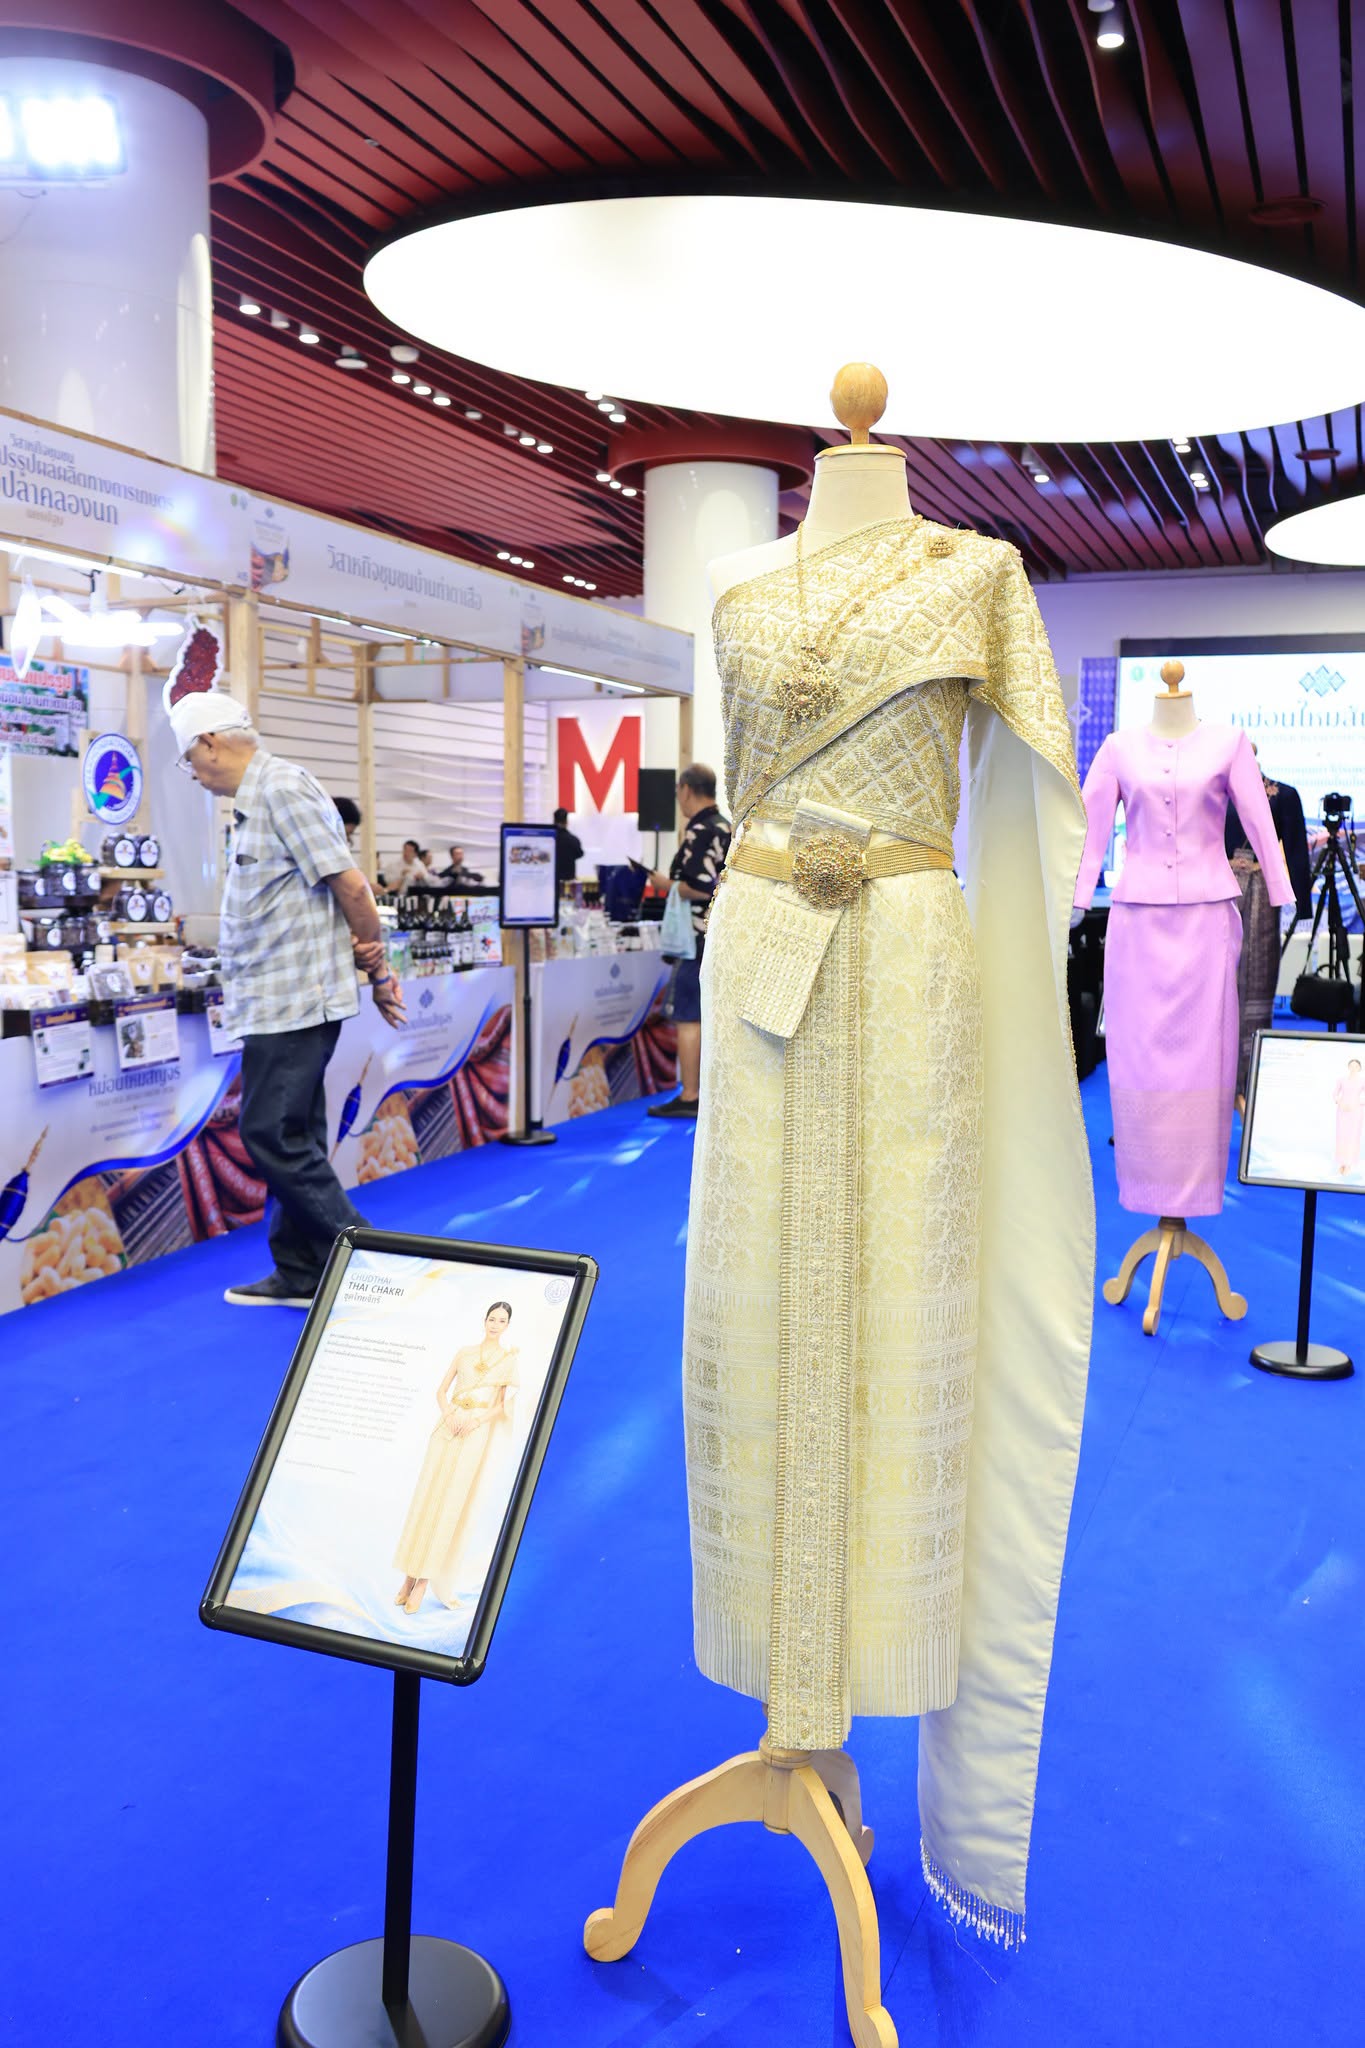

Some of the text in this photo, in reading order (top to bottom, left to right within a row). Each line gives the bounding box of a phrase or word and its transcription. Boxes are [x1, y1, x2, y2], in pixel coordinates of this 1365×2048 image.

[557, 716, 641, 813] M
[351, 1272, 392, 1285] CHUDTHAI
[348, 1281, 405, 1297] THAI CHAKRI
